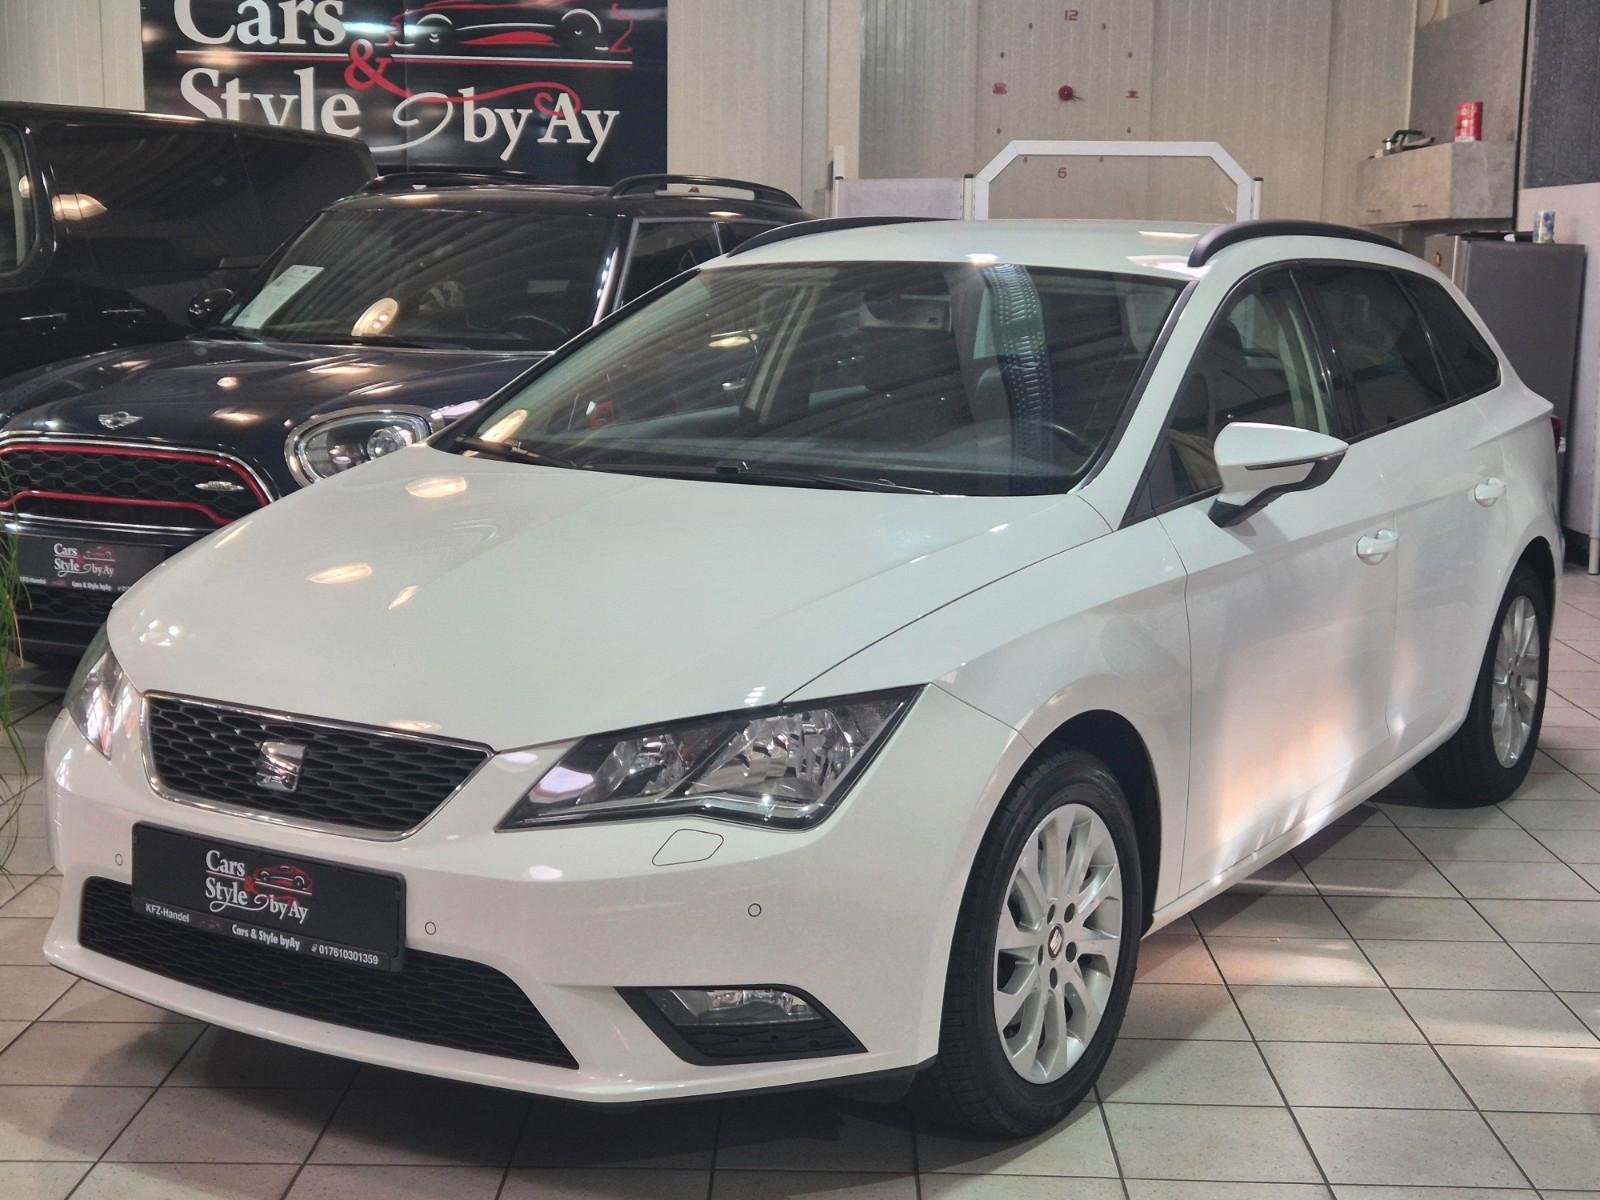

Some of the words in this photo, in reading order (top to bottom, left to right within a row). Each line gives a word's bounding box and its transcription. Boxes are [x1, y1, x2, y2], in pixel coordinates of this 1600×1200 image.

[173, 0, 347, 46] Cars
[1064, 9, 1079, 21] 12
[344, 38, 394, 93] &
[457, 86, 533, 161] by
[537, 92, 621, 163] Ay
[1057, 167, 1068, 179] 6
[53, 543, 78, 557] Cars
[54, 557, 82, 577] Style
[205, 849, 245, 877] Cars
[205, 877, 251, 912] Style
[269, 894, 287, 920] by
[287, 900, 309, 924] Ay
[145, 903, 190, 923] KFZ-Handel
[231, 923, 249, 938] Cars
[250, 928, 258, 940] &
[258, 930, 279, 945] Style
